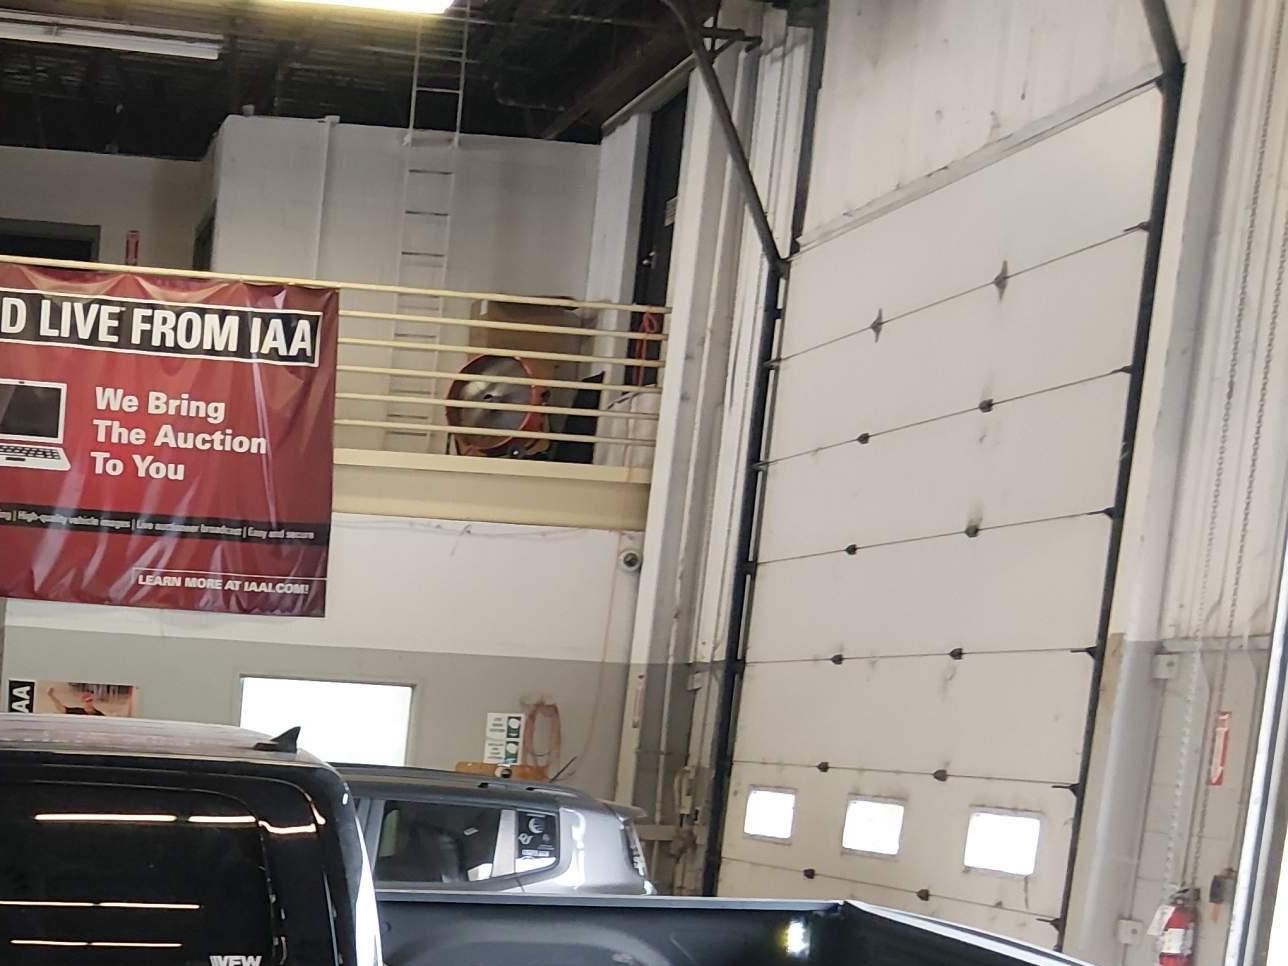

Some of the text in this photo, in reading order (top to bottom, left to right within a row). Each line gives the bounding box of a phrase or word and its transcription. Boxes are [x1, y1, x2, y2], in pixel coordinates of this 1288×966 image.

[39, 299, 123, 343] LIVE
[131, 306, 239, 353] FROM
[250, 317, 313, 356] IAA
[95, 386, 225, 424] We Bring
[93, 419, 267, 455] The Auction
[91, 452, 185, 481] To You
[138, 574, 181, 587] LEARN
[184, 577, 222, 590] MORE
[224, 580, 241, 591] AT
